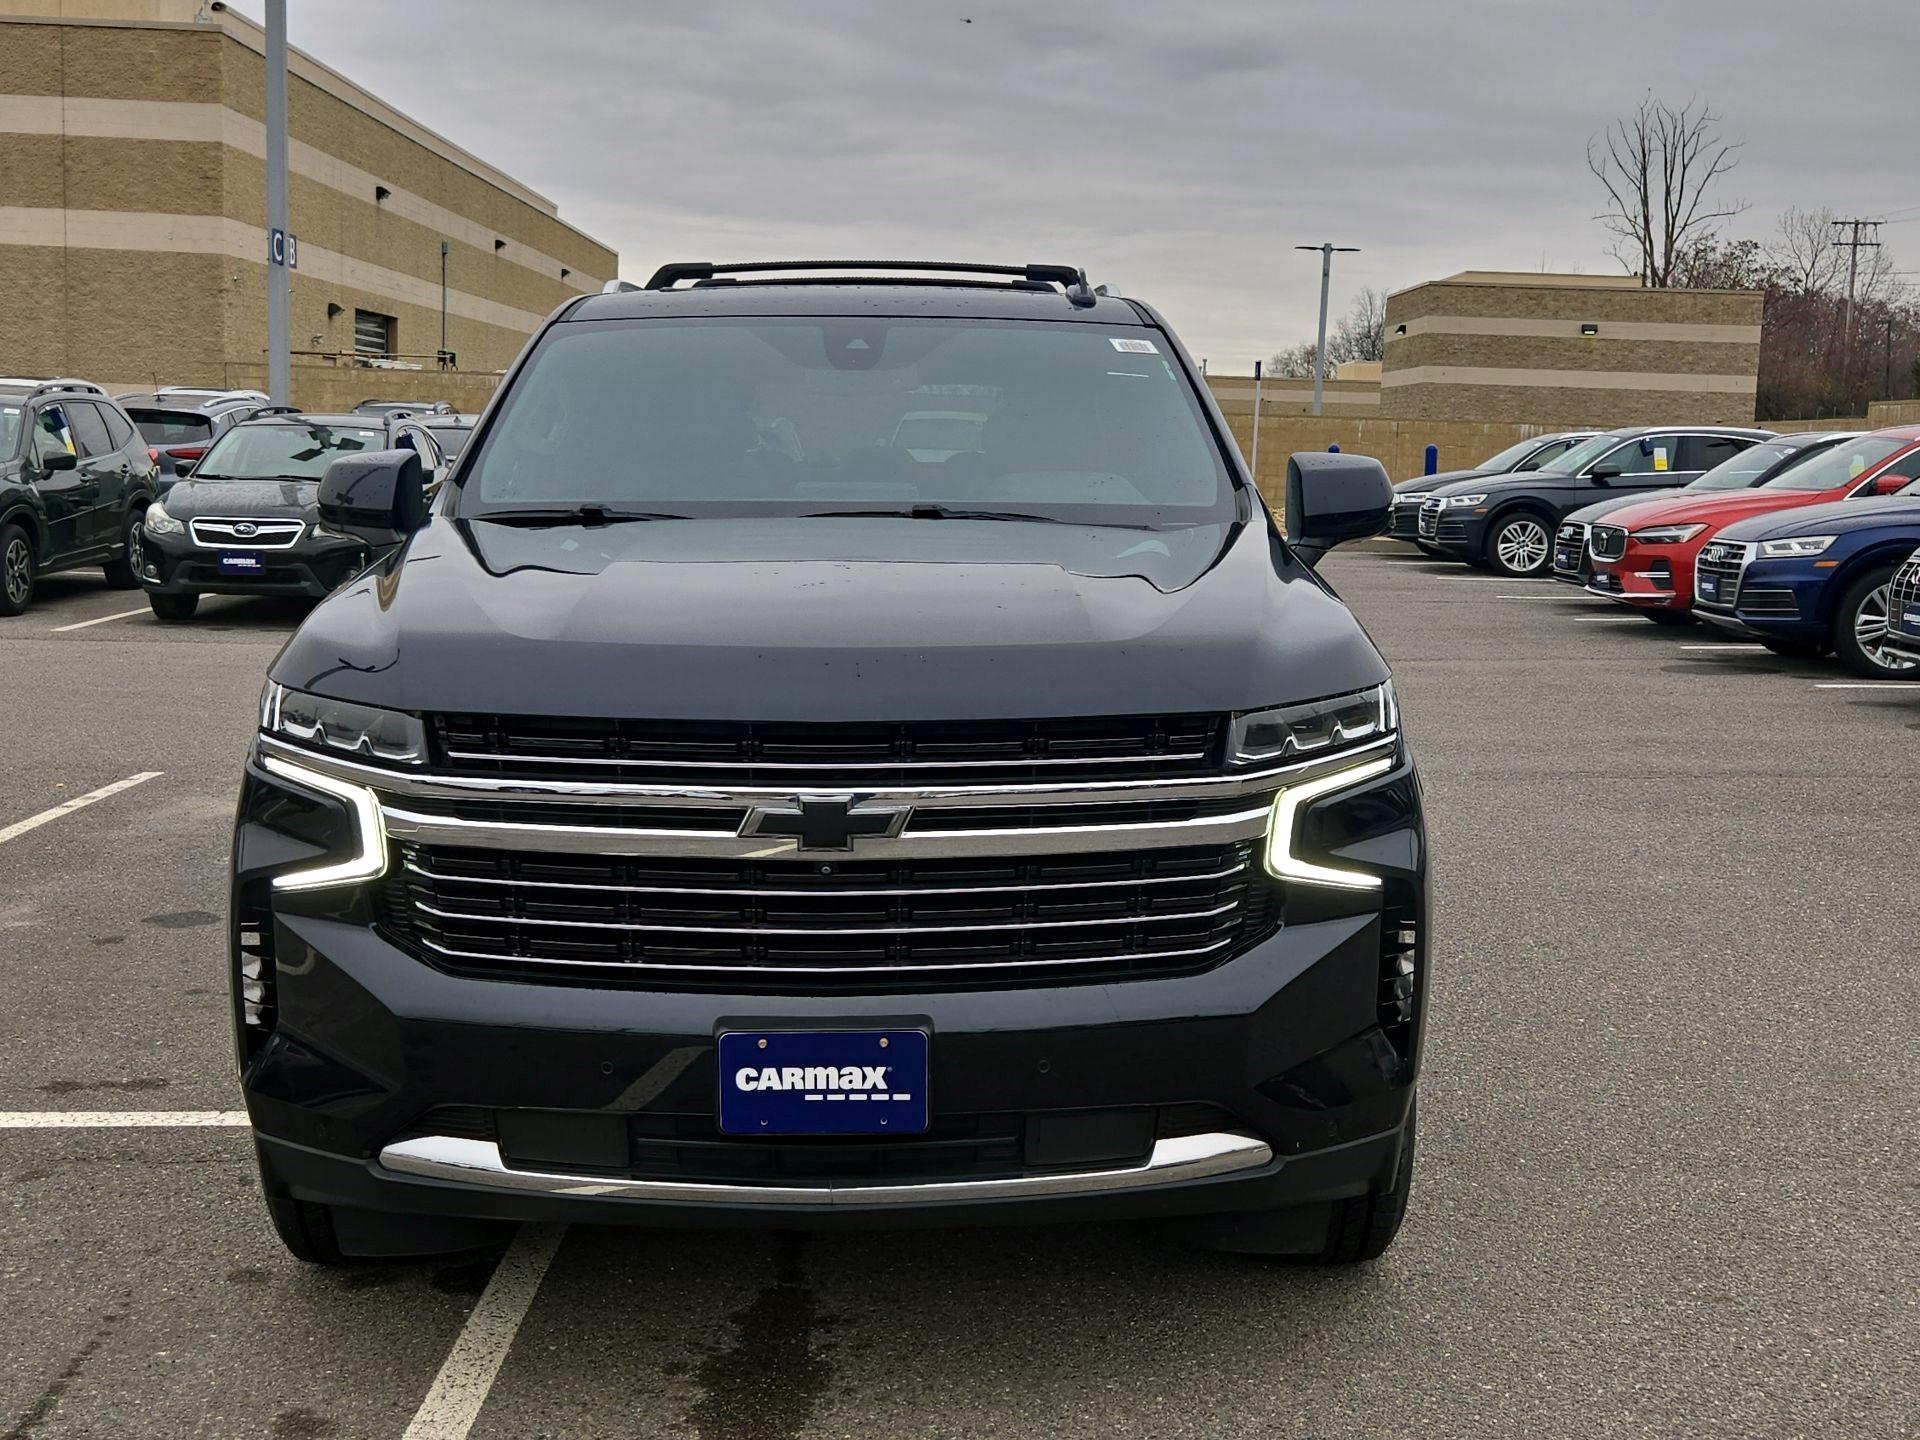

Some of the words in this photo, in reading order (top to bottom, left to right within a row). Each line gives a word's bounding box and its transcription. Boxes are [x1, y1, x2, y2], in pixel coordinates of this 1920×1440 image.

[273, 232, 283, 262] C
[288, 237, 296, 265] B
[735, 1066, 888, 1091] CARmax
